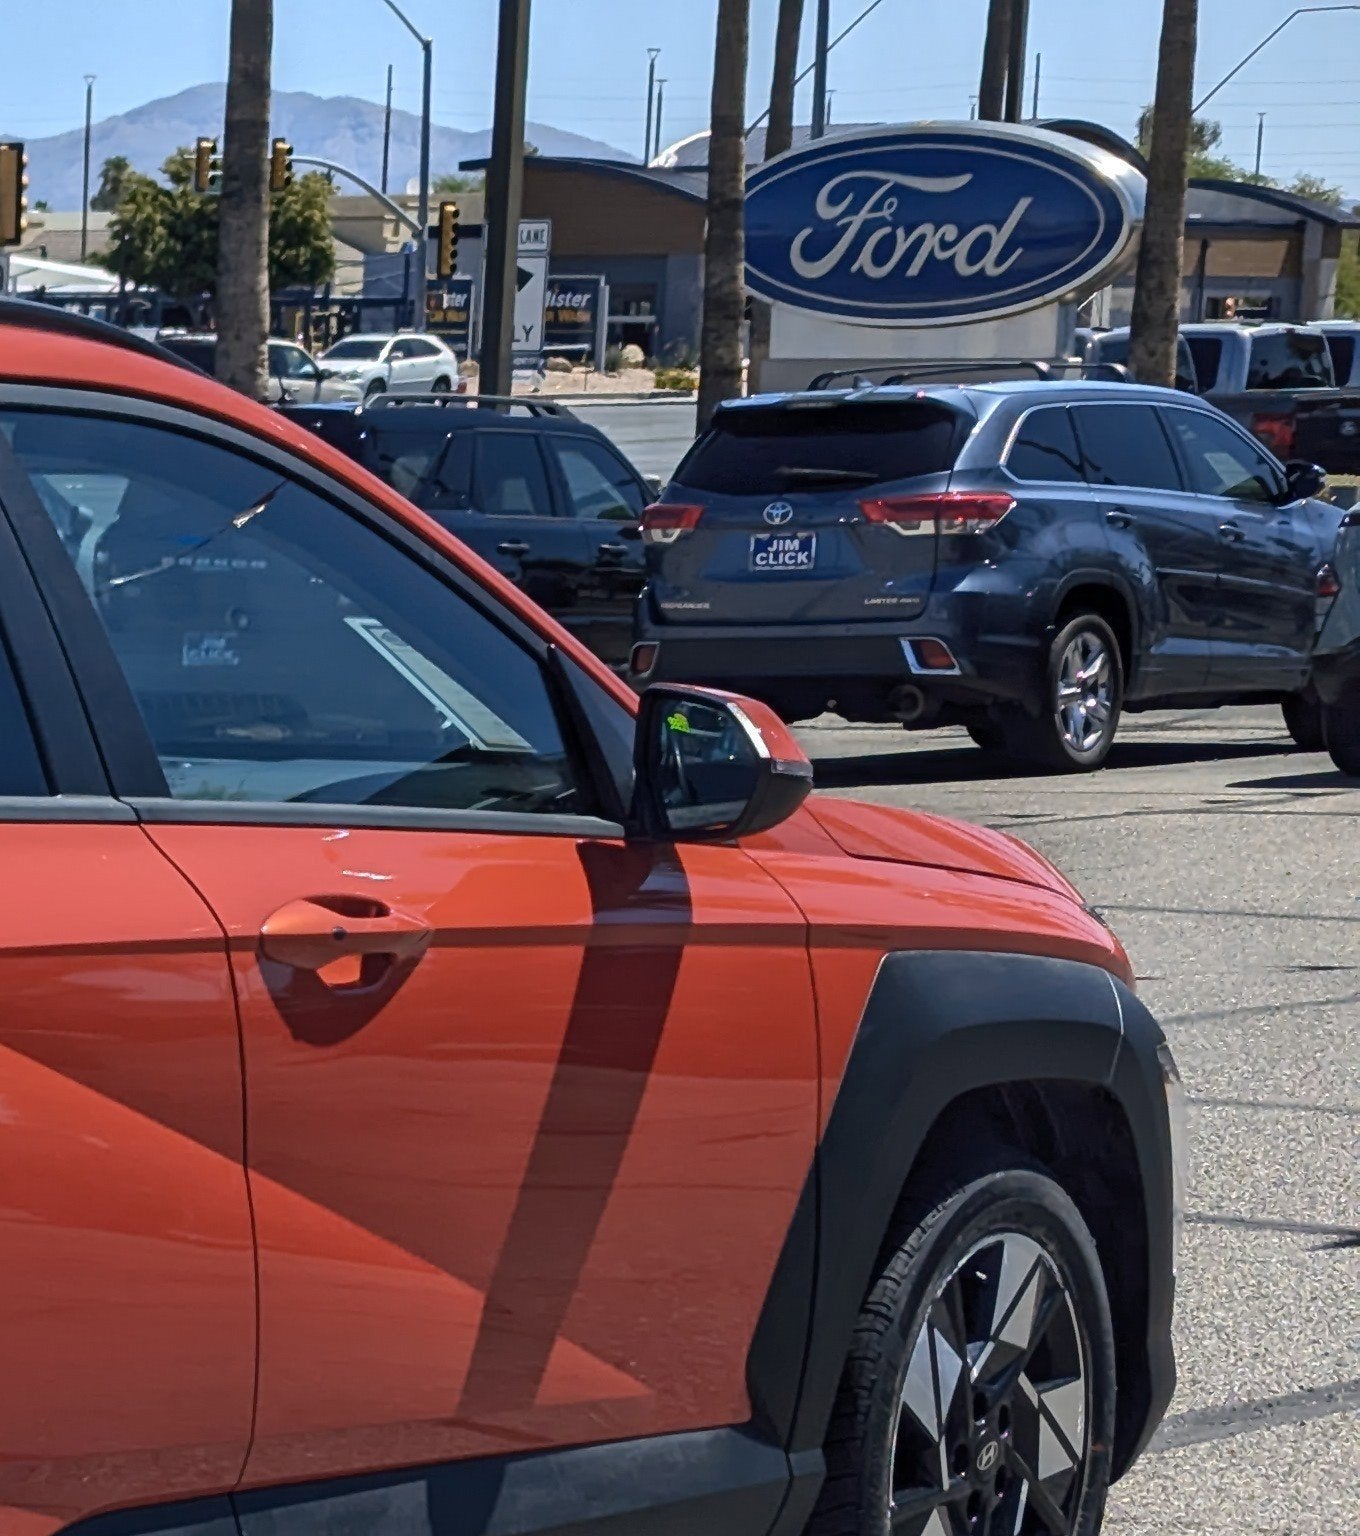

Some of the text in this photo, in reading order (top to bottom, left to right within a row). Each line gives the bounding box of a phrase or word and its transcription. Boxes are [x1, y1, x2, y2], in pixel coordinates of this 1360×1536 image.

[789, 169, 1034, 280] Ford
[520, 228, 546, 245] LANE
[767, 538, 800, 552] JIM
[755, 551, 809, 565] CLICK
